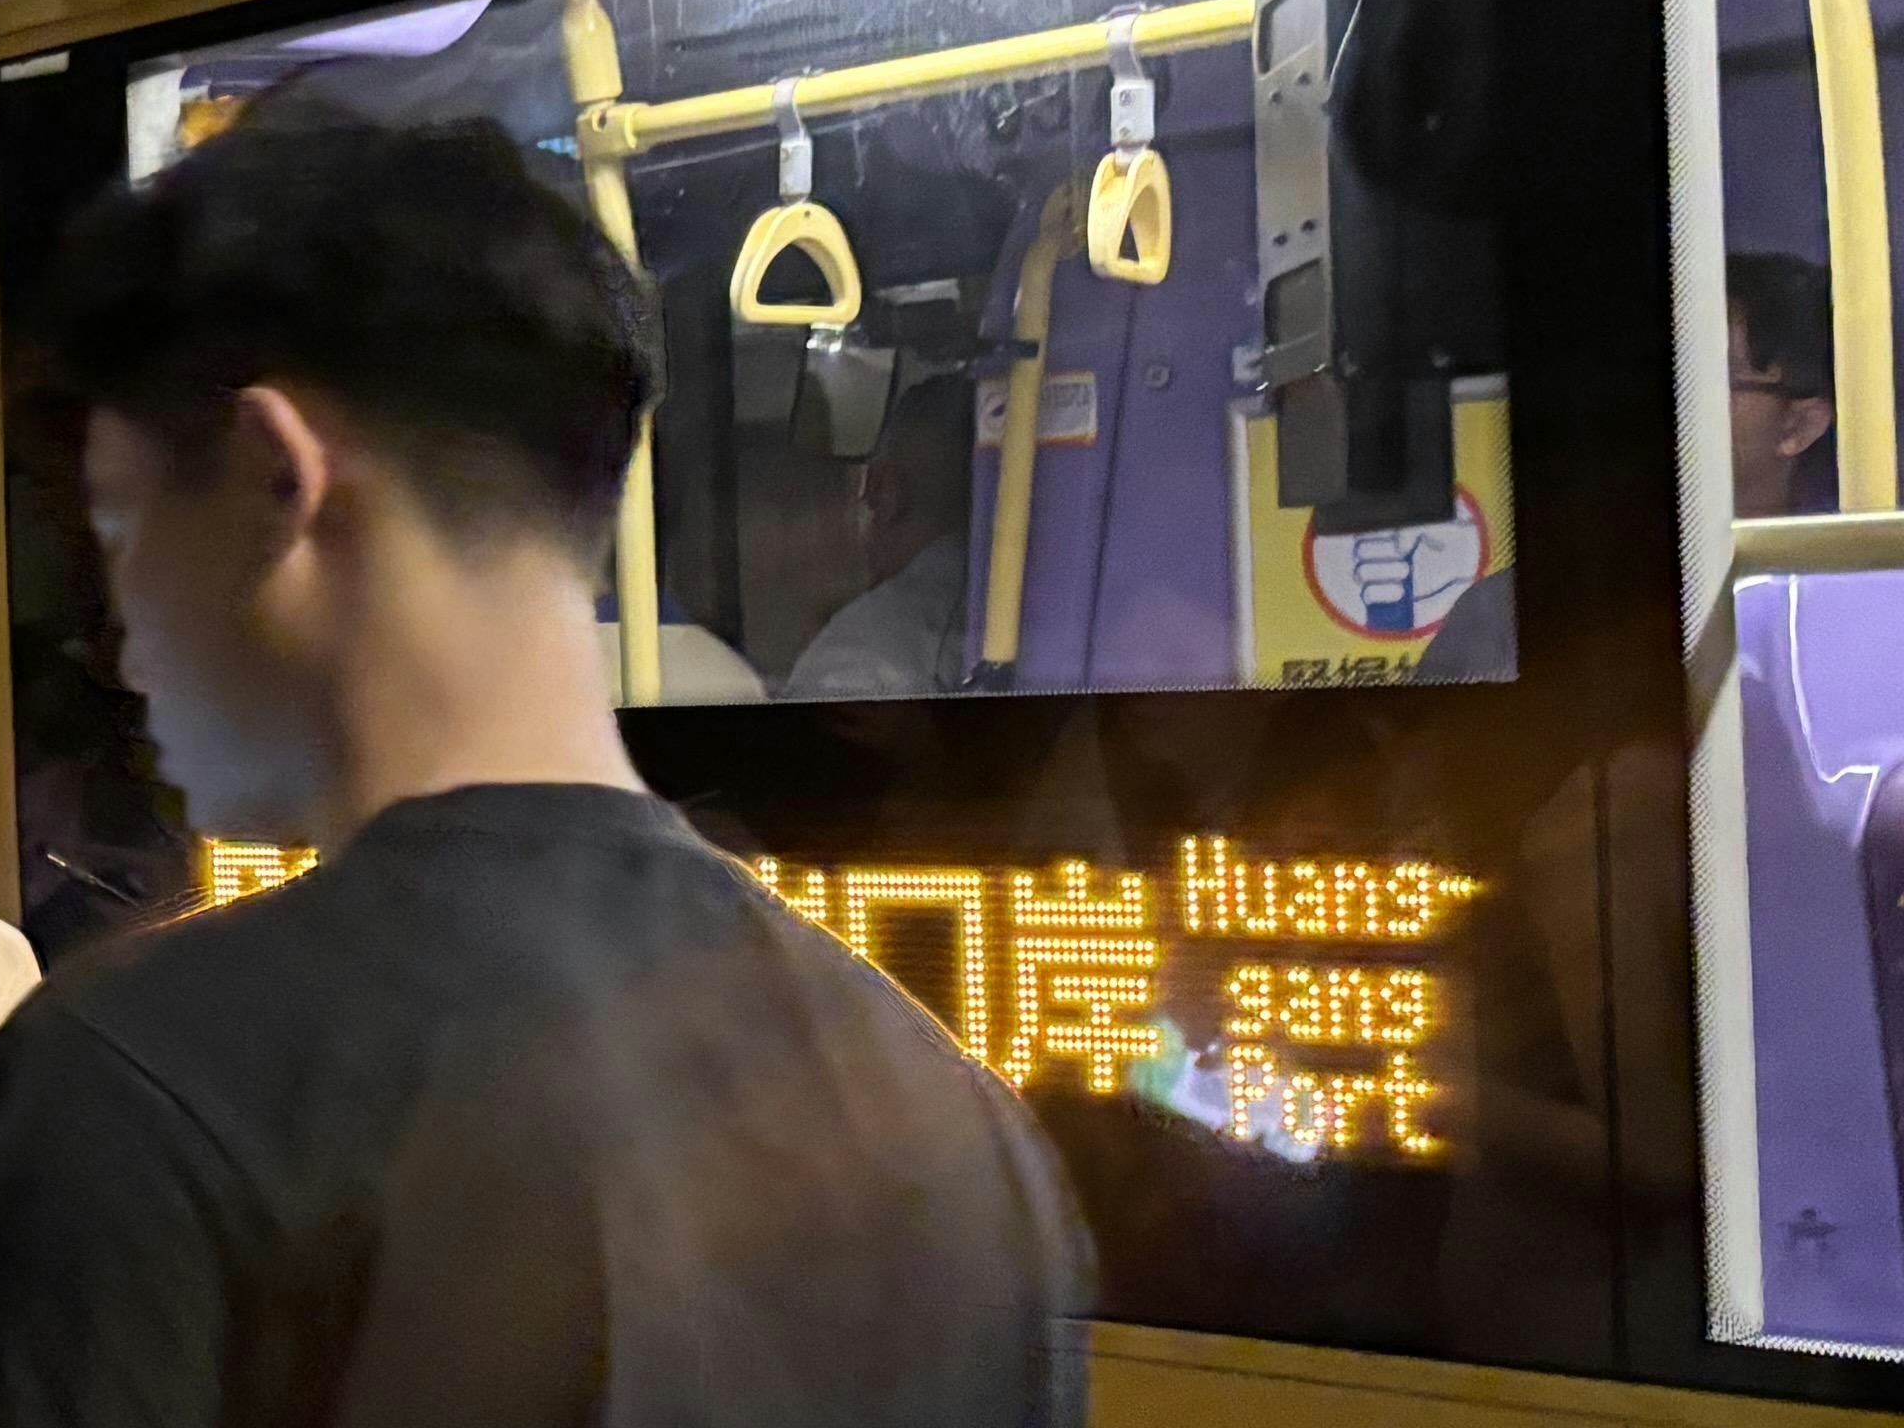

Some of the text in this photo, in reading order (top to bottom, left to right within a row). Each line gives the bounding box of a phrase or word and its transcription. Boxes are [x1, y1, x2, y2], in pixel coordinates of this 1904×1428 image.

[758, 857, 1159, 1092] 口岸
[1226, 966, 1426, 1042] gang
[1231, 1045, 1437, 1152] Port
